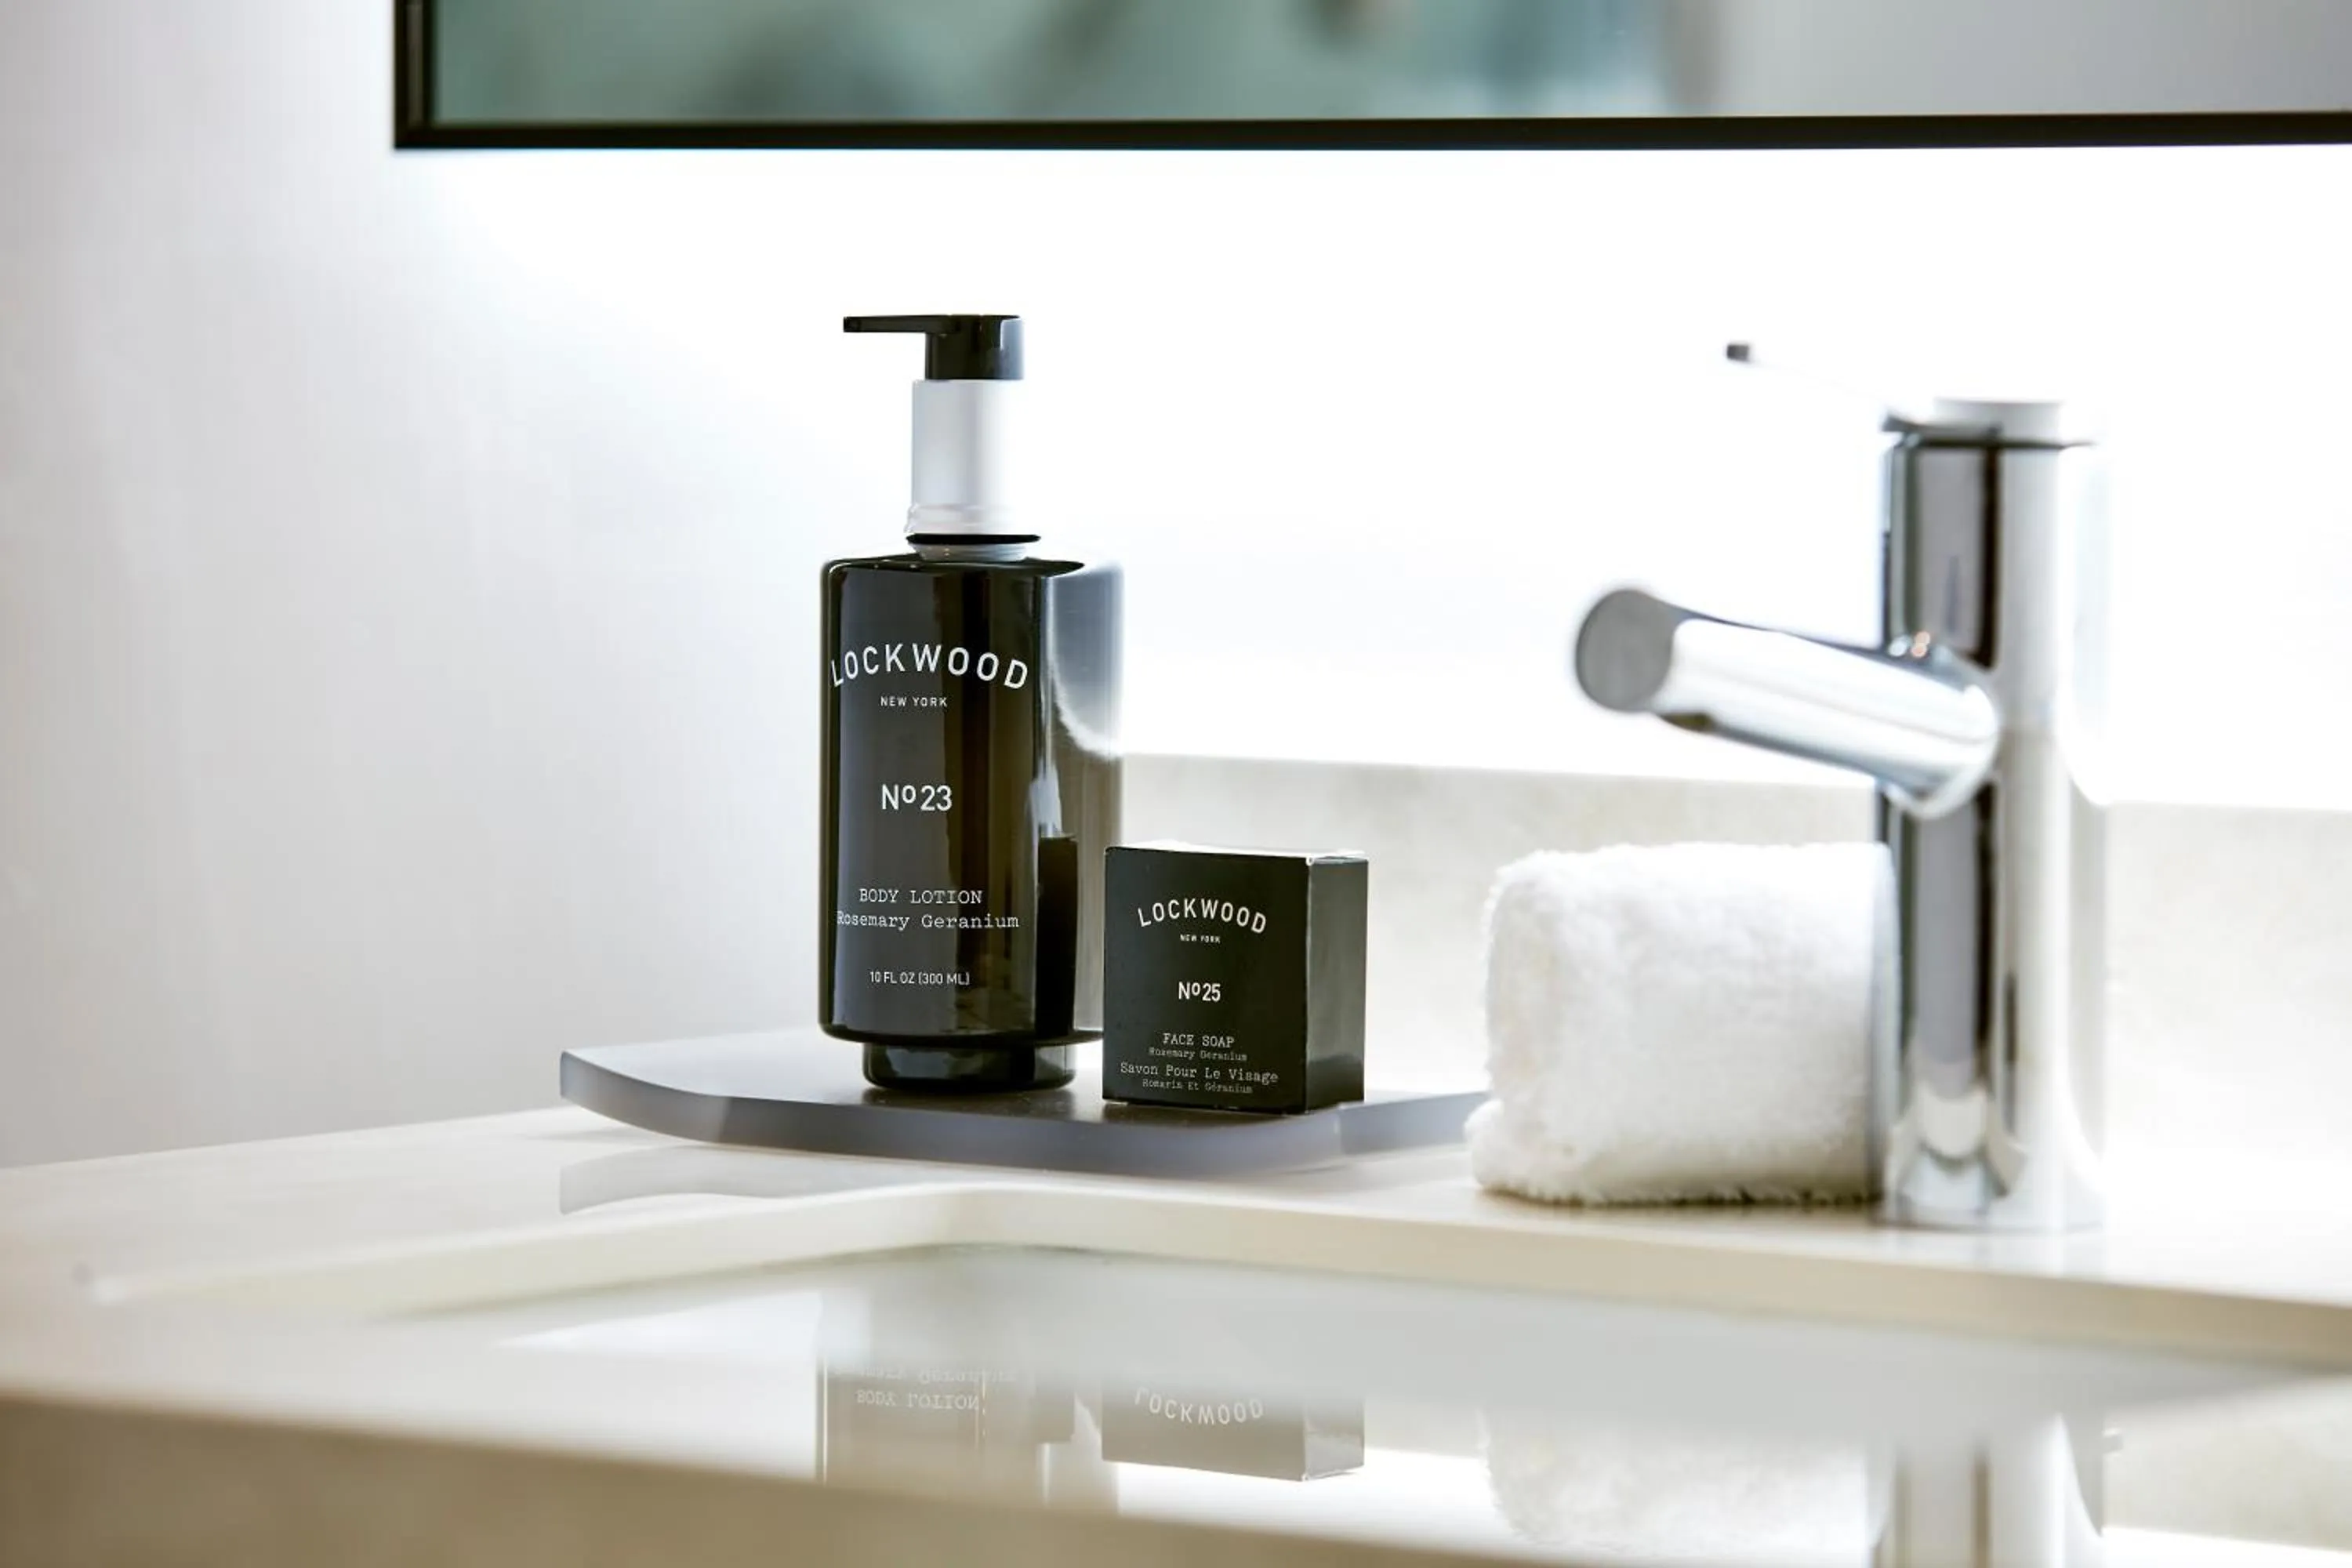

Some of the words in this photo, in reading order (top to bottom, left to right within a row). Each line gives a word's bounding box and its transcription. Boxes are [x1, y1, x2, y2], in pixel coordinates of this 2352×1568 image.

[830, 642, 1028, 689] LOCKWOOD
[880, 696, 907, 706] NEW
[913, 697, 948, 707] YORK
[859, 888, 899, 903] BODY
[910, 890, 982, 905] LOTION
[837, 910, 910, 931] Rosemary
[921, 913, 1019, 928] Geranium
[1138, 898, 1266, 934] LOCKWOOD
[1200, 935, 1221, 943] YORK
[869, 971, 881, 983] 10
[884, 972, 897, 984] FL
[900, 972, 915, 984] OZ
[1163, 1033, 1194, 1046] FACE
[1202, 1036, 1235, 1048] SOAP
[1149, 1047, 1195, 1059] Rosemary
[1200, 1050, 1247, 1062] Geranium
[1120, 1062, 1158, 1075] Savon
[1166, 1065, 1196, 1078] Pour
[1205, 1067, 1220, 1080] Le
[1229, 1069, 1279, 1085] Visage
[1188, 1080, 1199, 1091] Et
